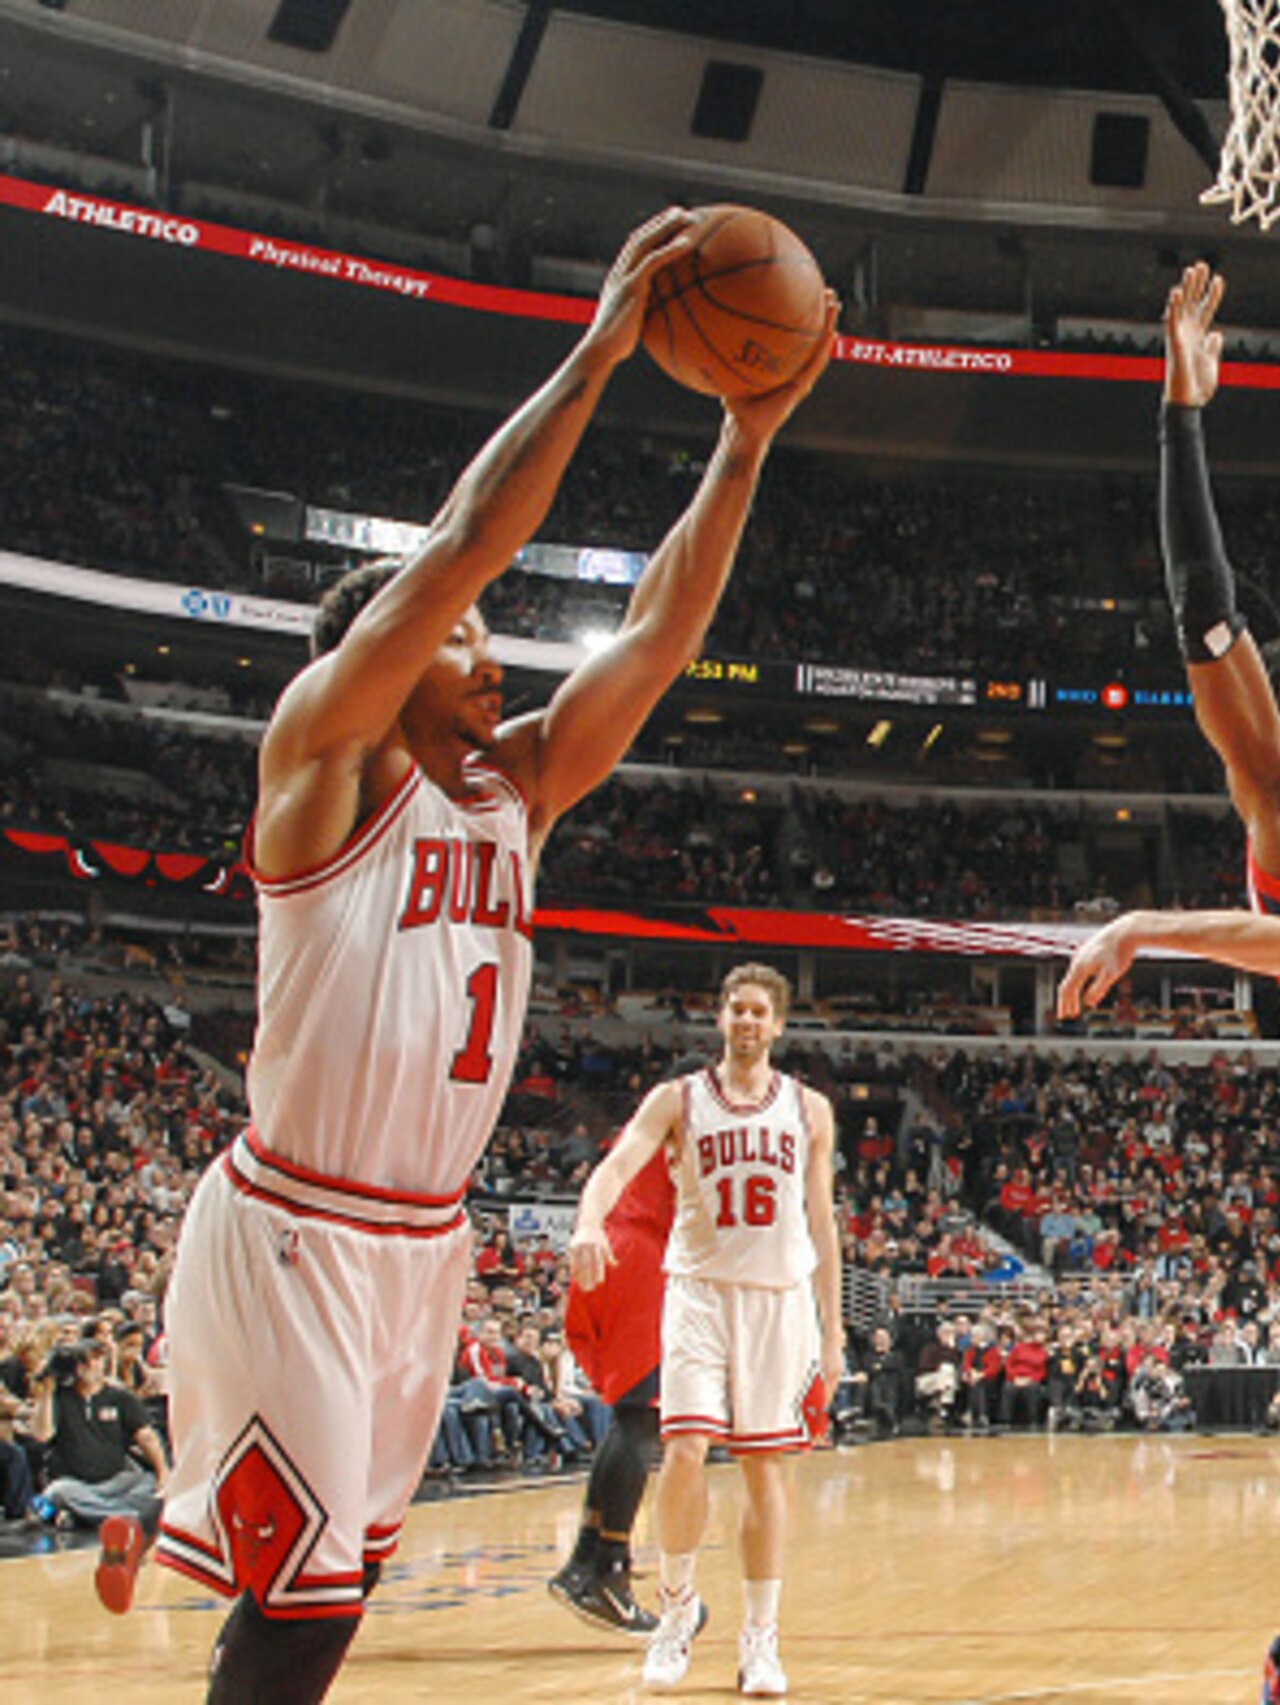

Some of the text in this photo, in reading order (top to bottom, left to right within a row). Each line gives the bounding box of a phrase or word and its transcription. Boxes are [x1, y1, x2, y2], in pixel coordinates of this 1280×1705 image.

[43, 190, 199, 246] ATHLETICO
[249, 238, 430, 297] Physical Therapy
[728, 662, 757, 683] PM
[449, 962, 499, 1085] 1
[697, 1126, 796, 1179] BULLS
[715, 1174, 776, 1229] 16
